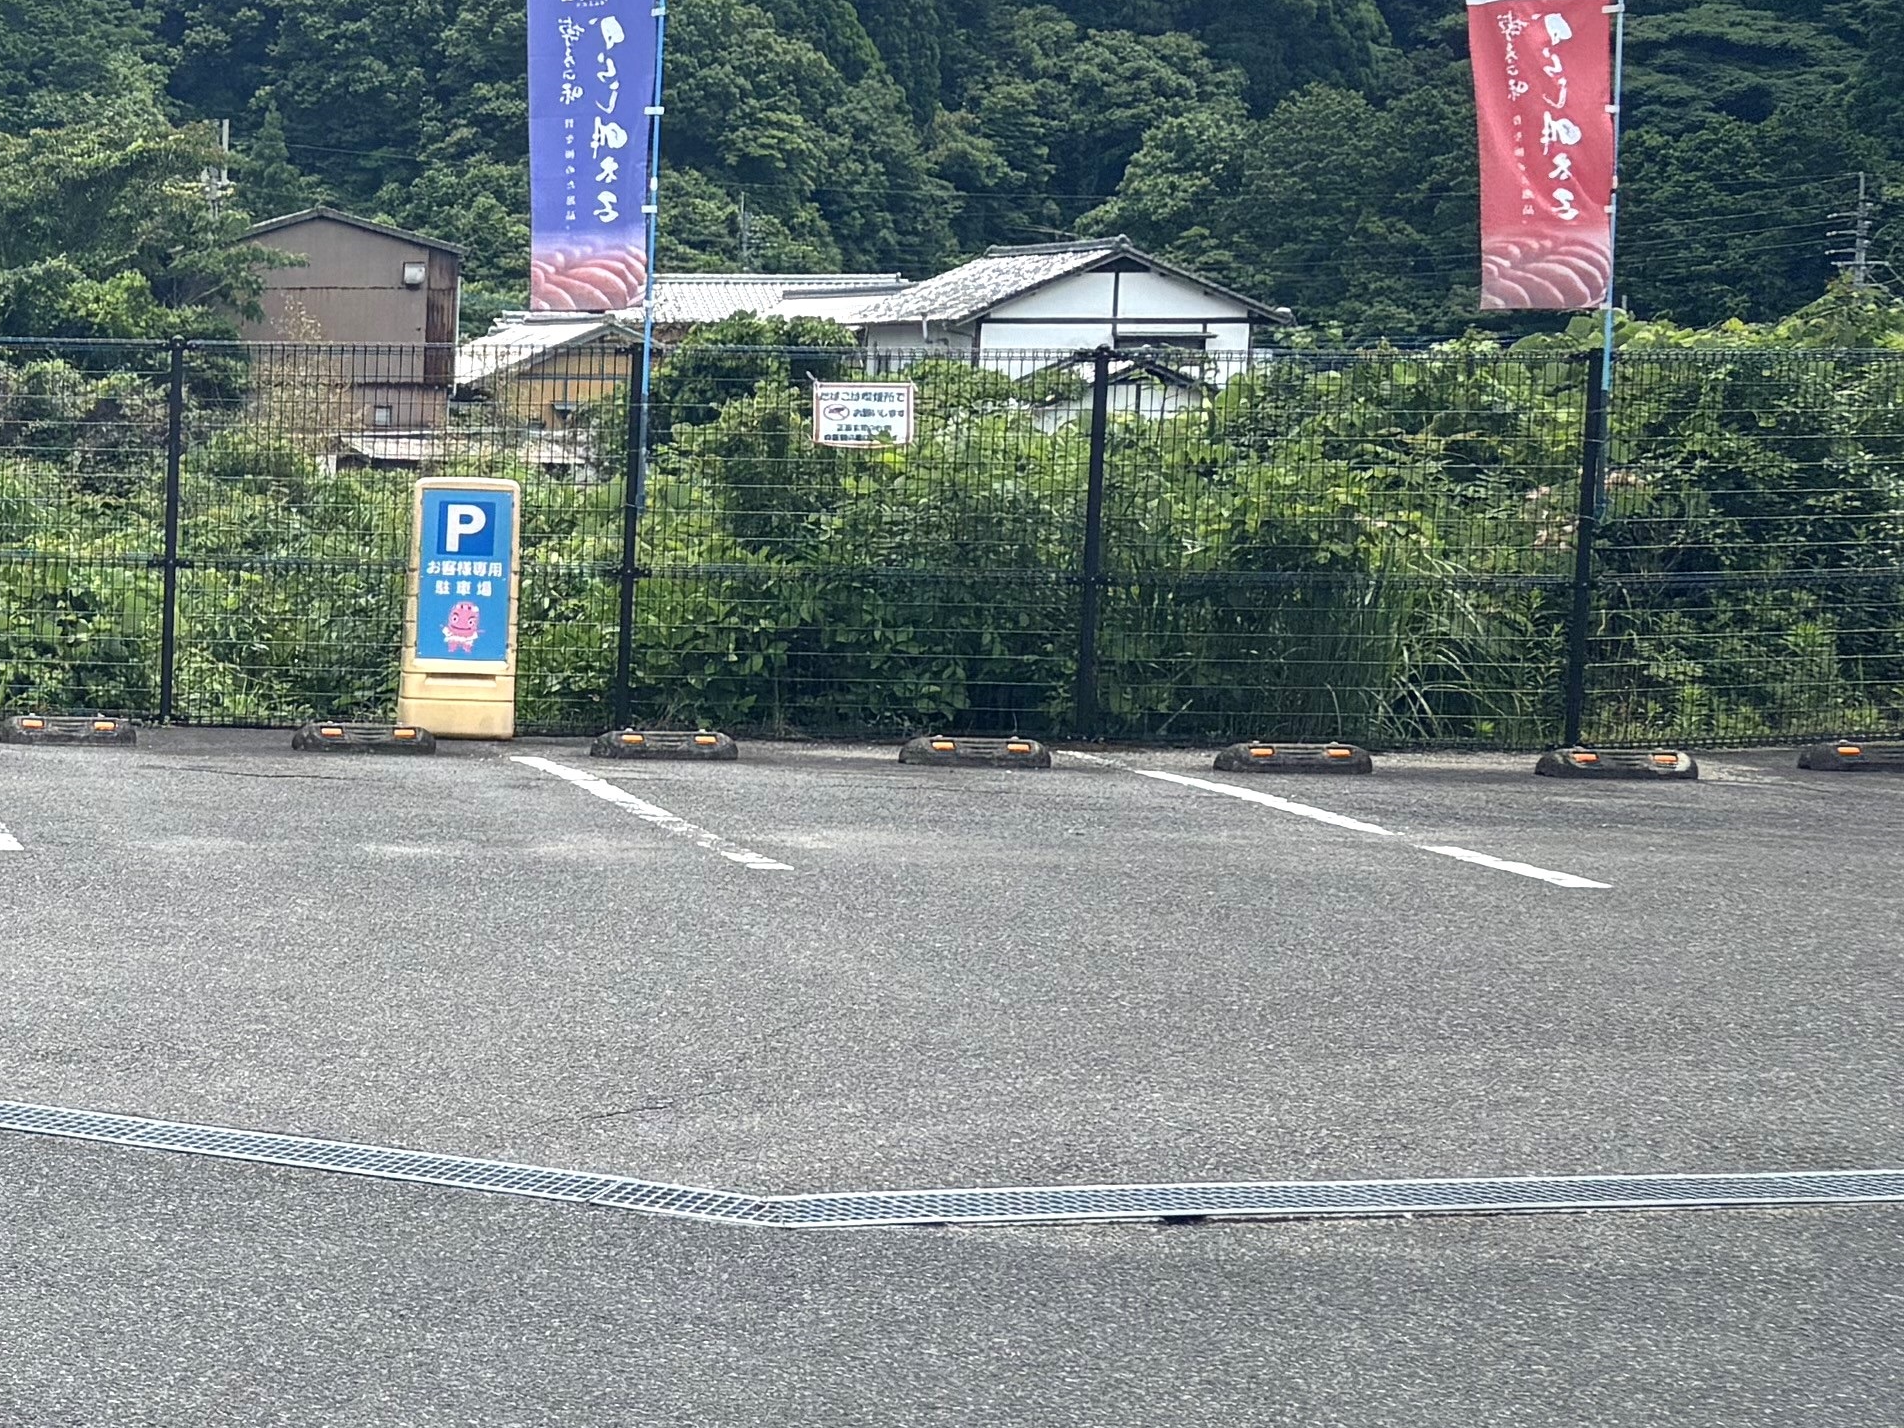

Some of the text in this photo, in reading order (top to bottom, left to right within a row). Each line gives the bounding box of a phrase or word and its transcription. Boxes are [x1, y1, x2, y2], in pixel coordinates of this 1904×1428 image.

[445, 503, 487, 553] P
[425, 559, 504, 578] お客様専用
[434, 579, 493, 597] 駐車場
